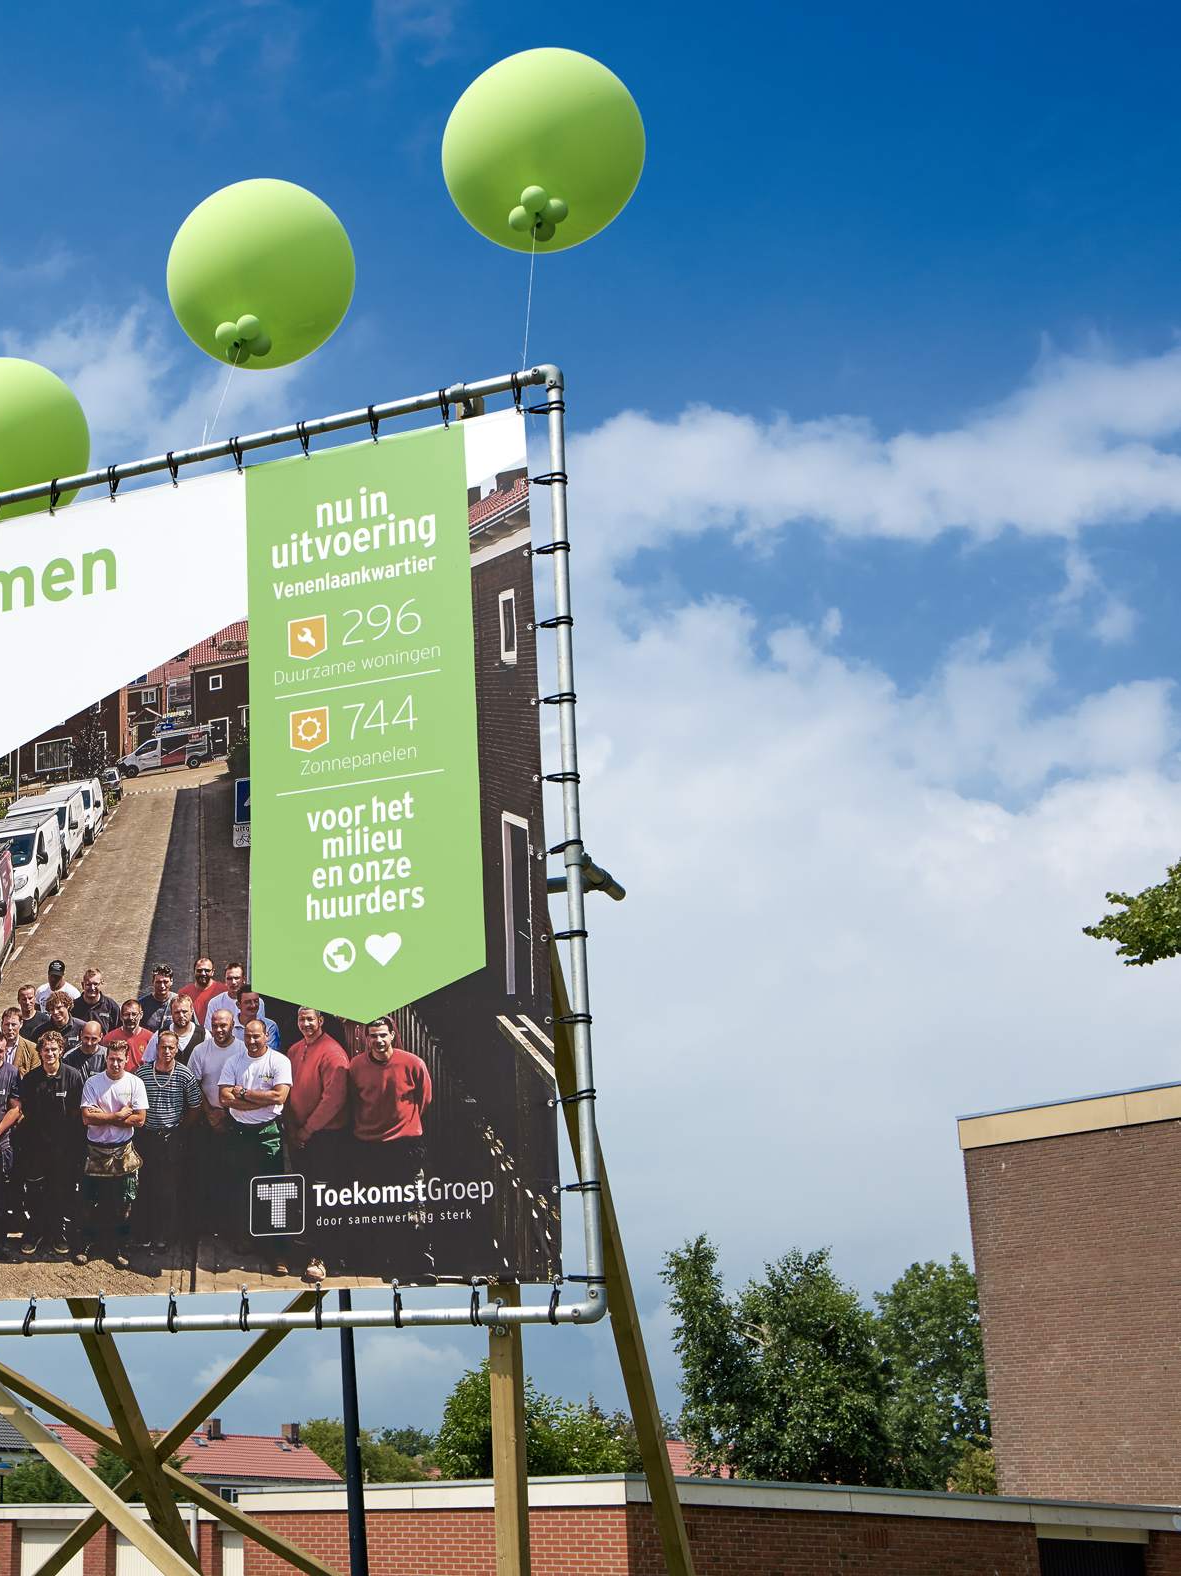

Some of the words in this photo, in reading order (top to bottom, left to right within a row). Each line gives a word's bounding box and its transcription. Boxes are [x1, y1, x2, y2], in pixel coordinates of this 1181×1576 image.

[315, 497, 354, 529] nu
[358, 486, 388, 521] in
[271, 512, 437, 570] uitvoering
[272, 555, 437, 600] Venenlaankwartier
[341, 597, 424, 648] 296
[274, 660, 356, 686] Duurzame
[361, 645, 442, 671] woningen
[341, 693, 419, 741] 744
[300, 745, 419, 776] Zonnepanelen
[306, 804, 367, 833] voor
[371, 791, 415, 824] het
[322, 825, 403, 860] milieu
[312, 865, 343, 890] en
[348, 856, 412, 885] onze
[306, 885, 425, 922] huurders
[311, 1176, 495, 1207] ToekomstGroep
[315, 1215, 343, 1227] door
[348, 1210, 434, 1226] samenwerking
[440, 1208, 473, 1221] sterk
